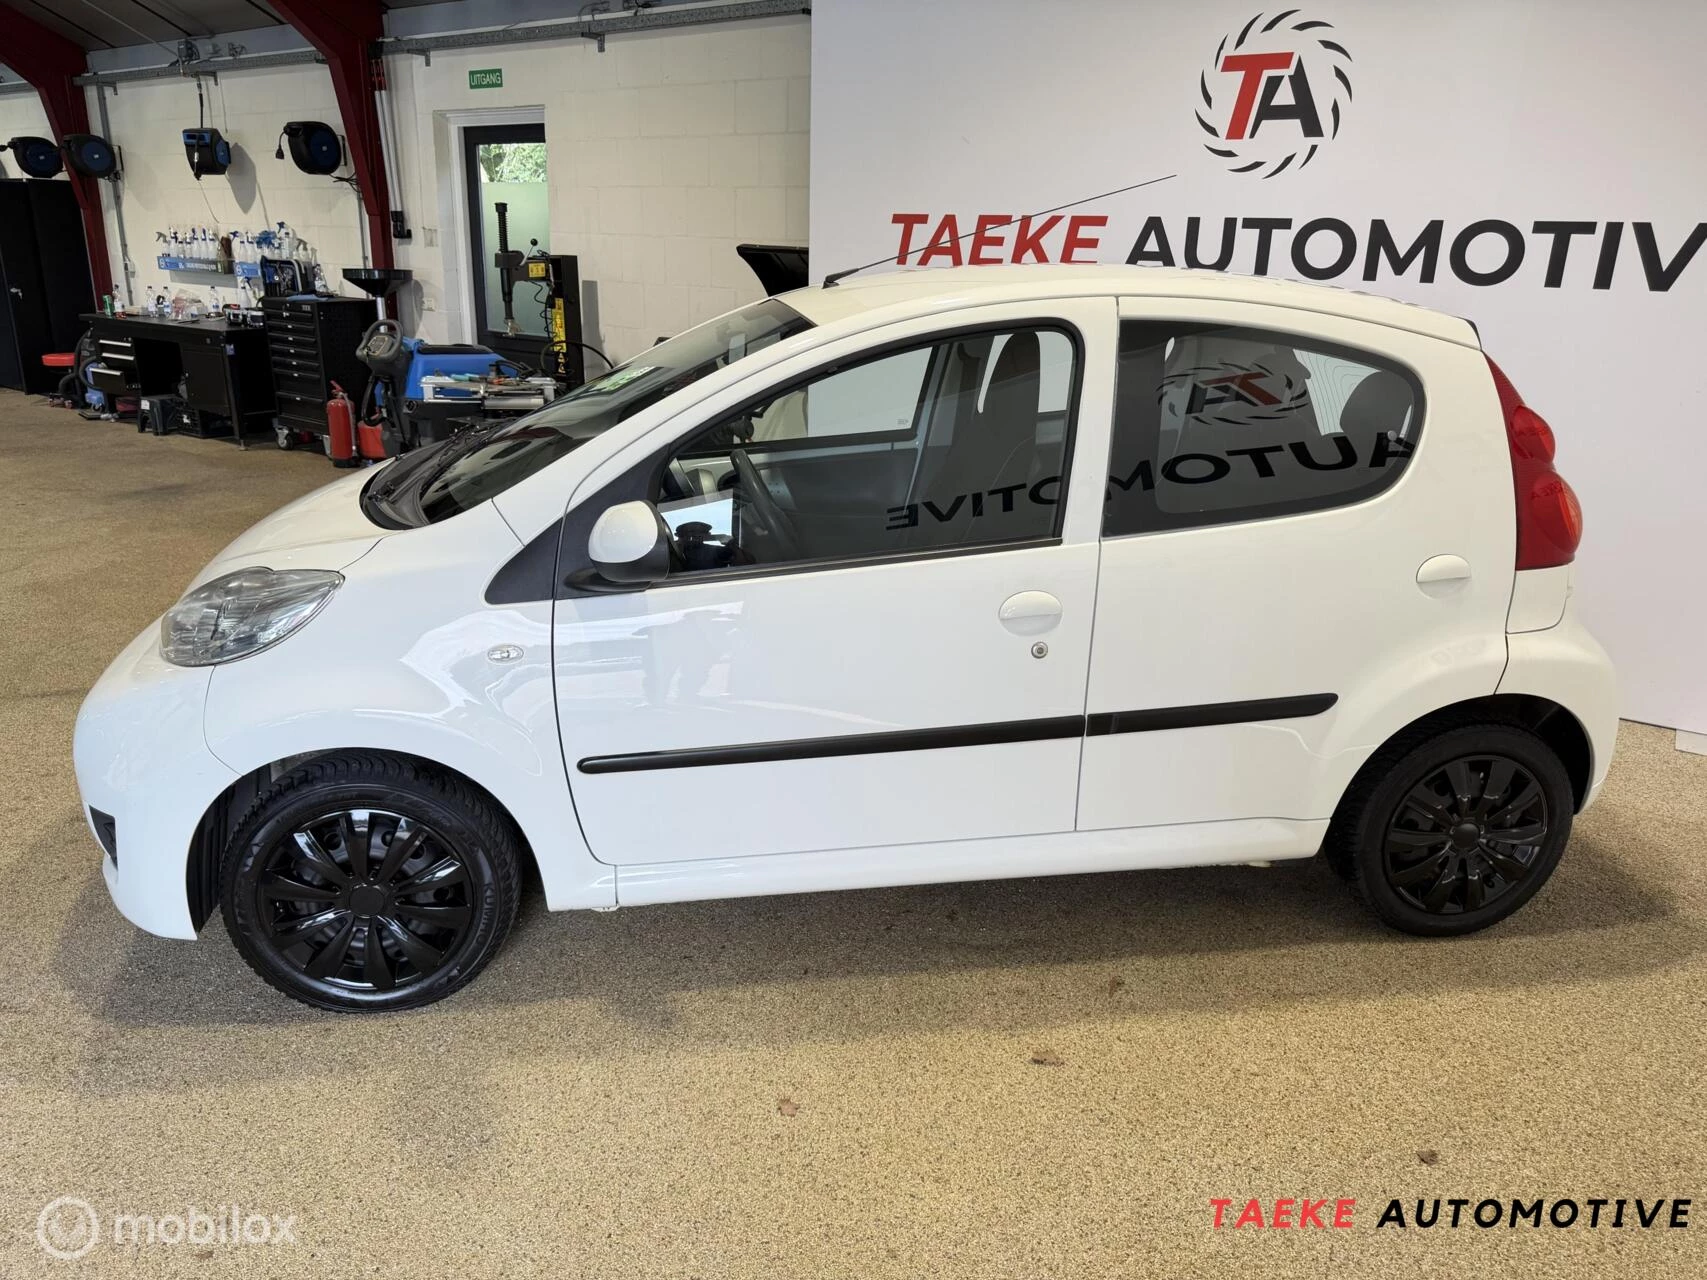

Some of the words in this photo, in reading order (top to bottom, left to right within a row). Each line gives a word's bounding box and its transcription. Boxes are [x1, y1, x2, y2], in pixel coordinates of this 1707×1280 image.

[470, 72, 501, 86] UITGANG
[1220, 51, 1324, 141] TA
[891, 213, 1109, 267] TAEKE
